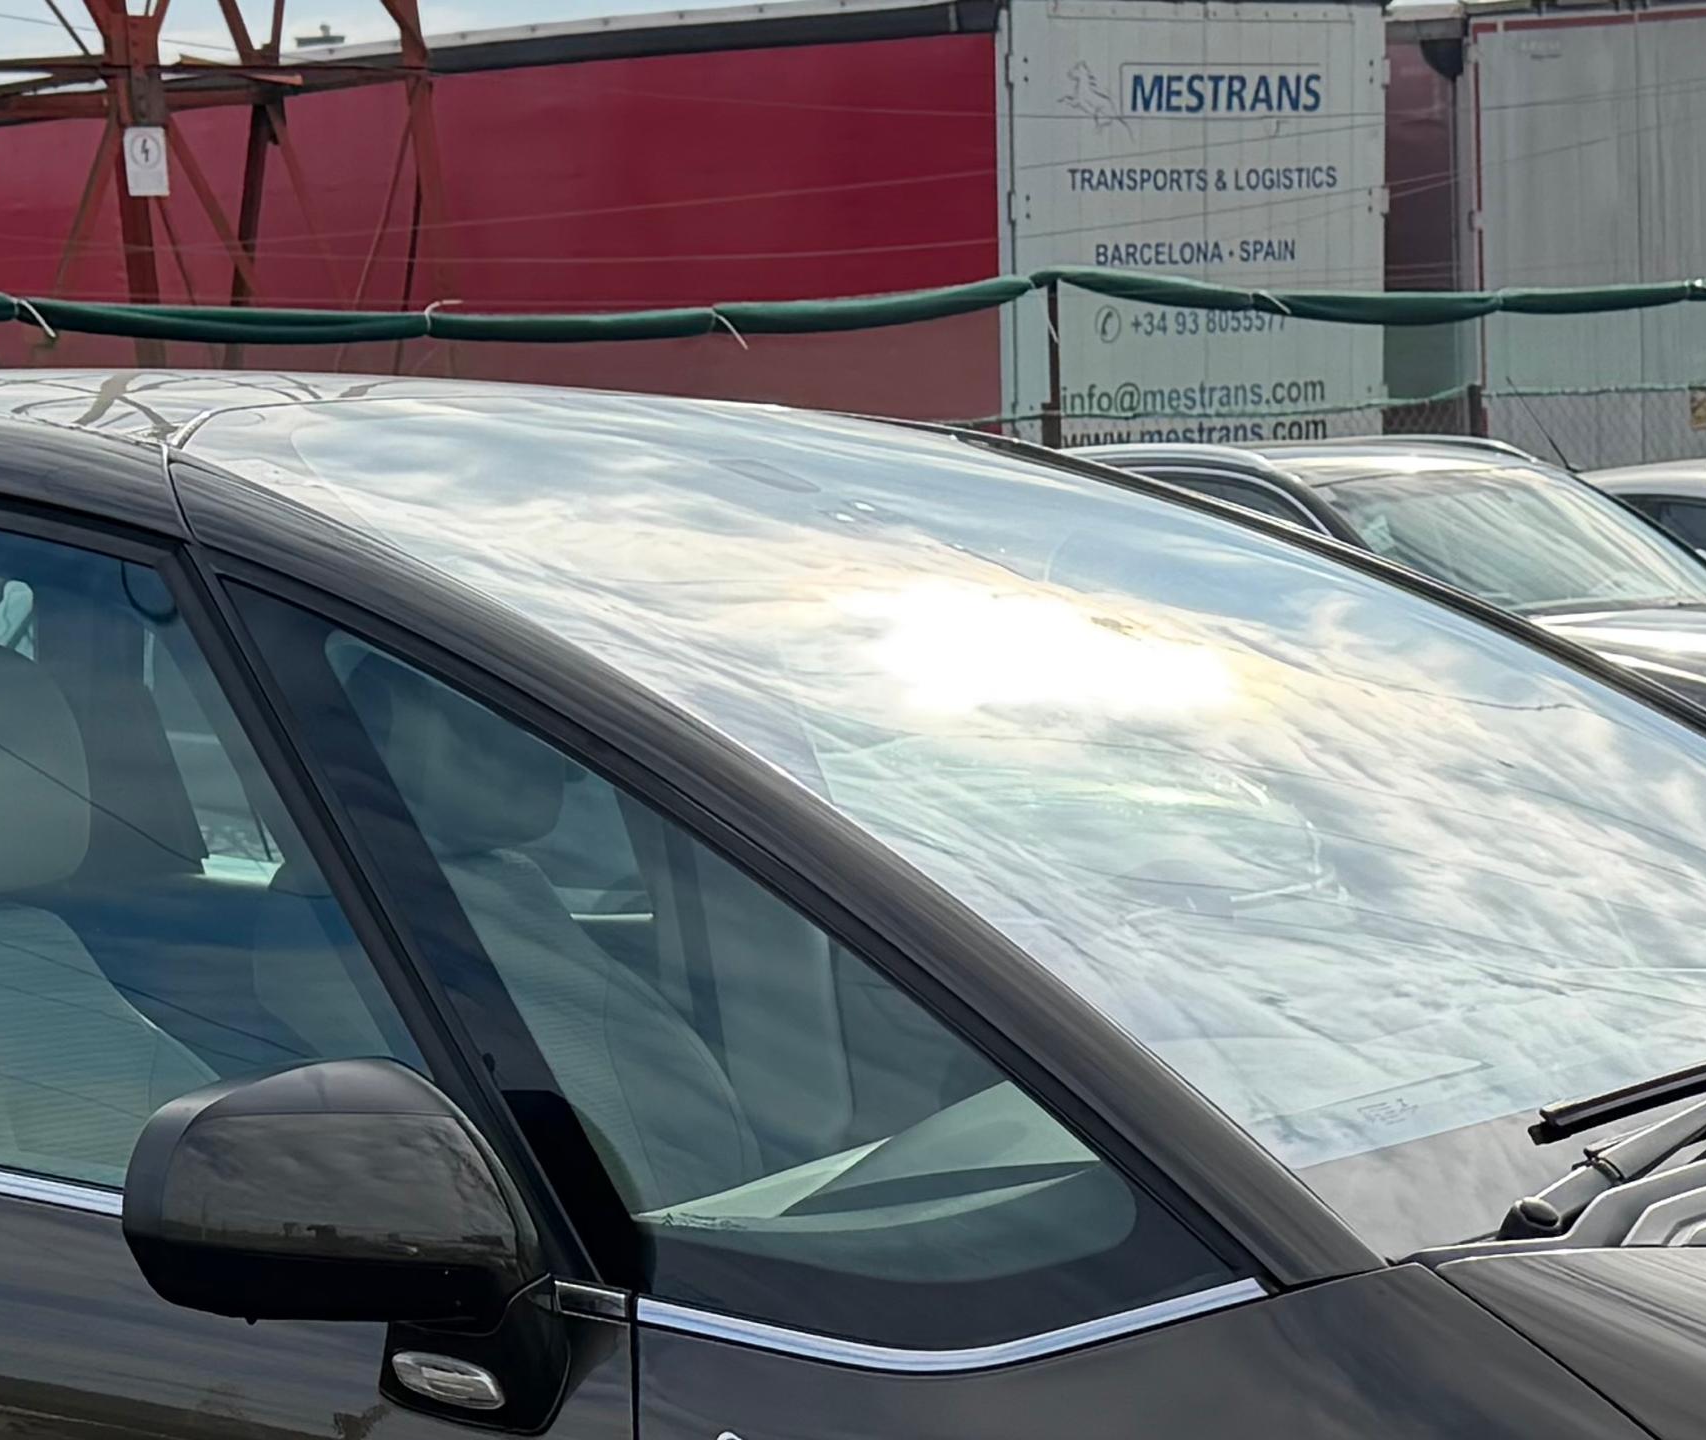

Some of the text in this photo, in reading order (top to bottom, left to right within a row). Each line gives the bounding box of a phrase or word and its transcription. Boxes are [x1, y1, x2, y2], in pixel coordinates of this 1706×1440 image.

[1131, 73, 1322, 113] MESTRANS
[1068, 166, 1338, 192] TRANSPORTS & LOGISTICS
[1095, 239, 1296, 266] BARCELONA SPAIN
[1131, 311, 1168, 336] +34
[1174, 311, 1200, 335] 93
[1061, 379, 1325, 413] info@mestrans.com
[1062, 418, 1327, 449] wwwmestranscom
